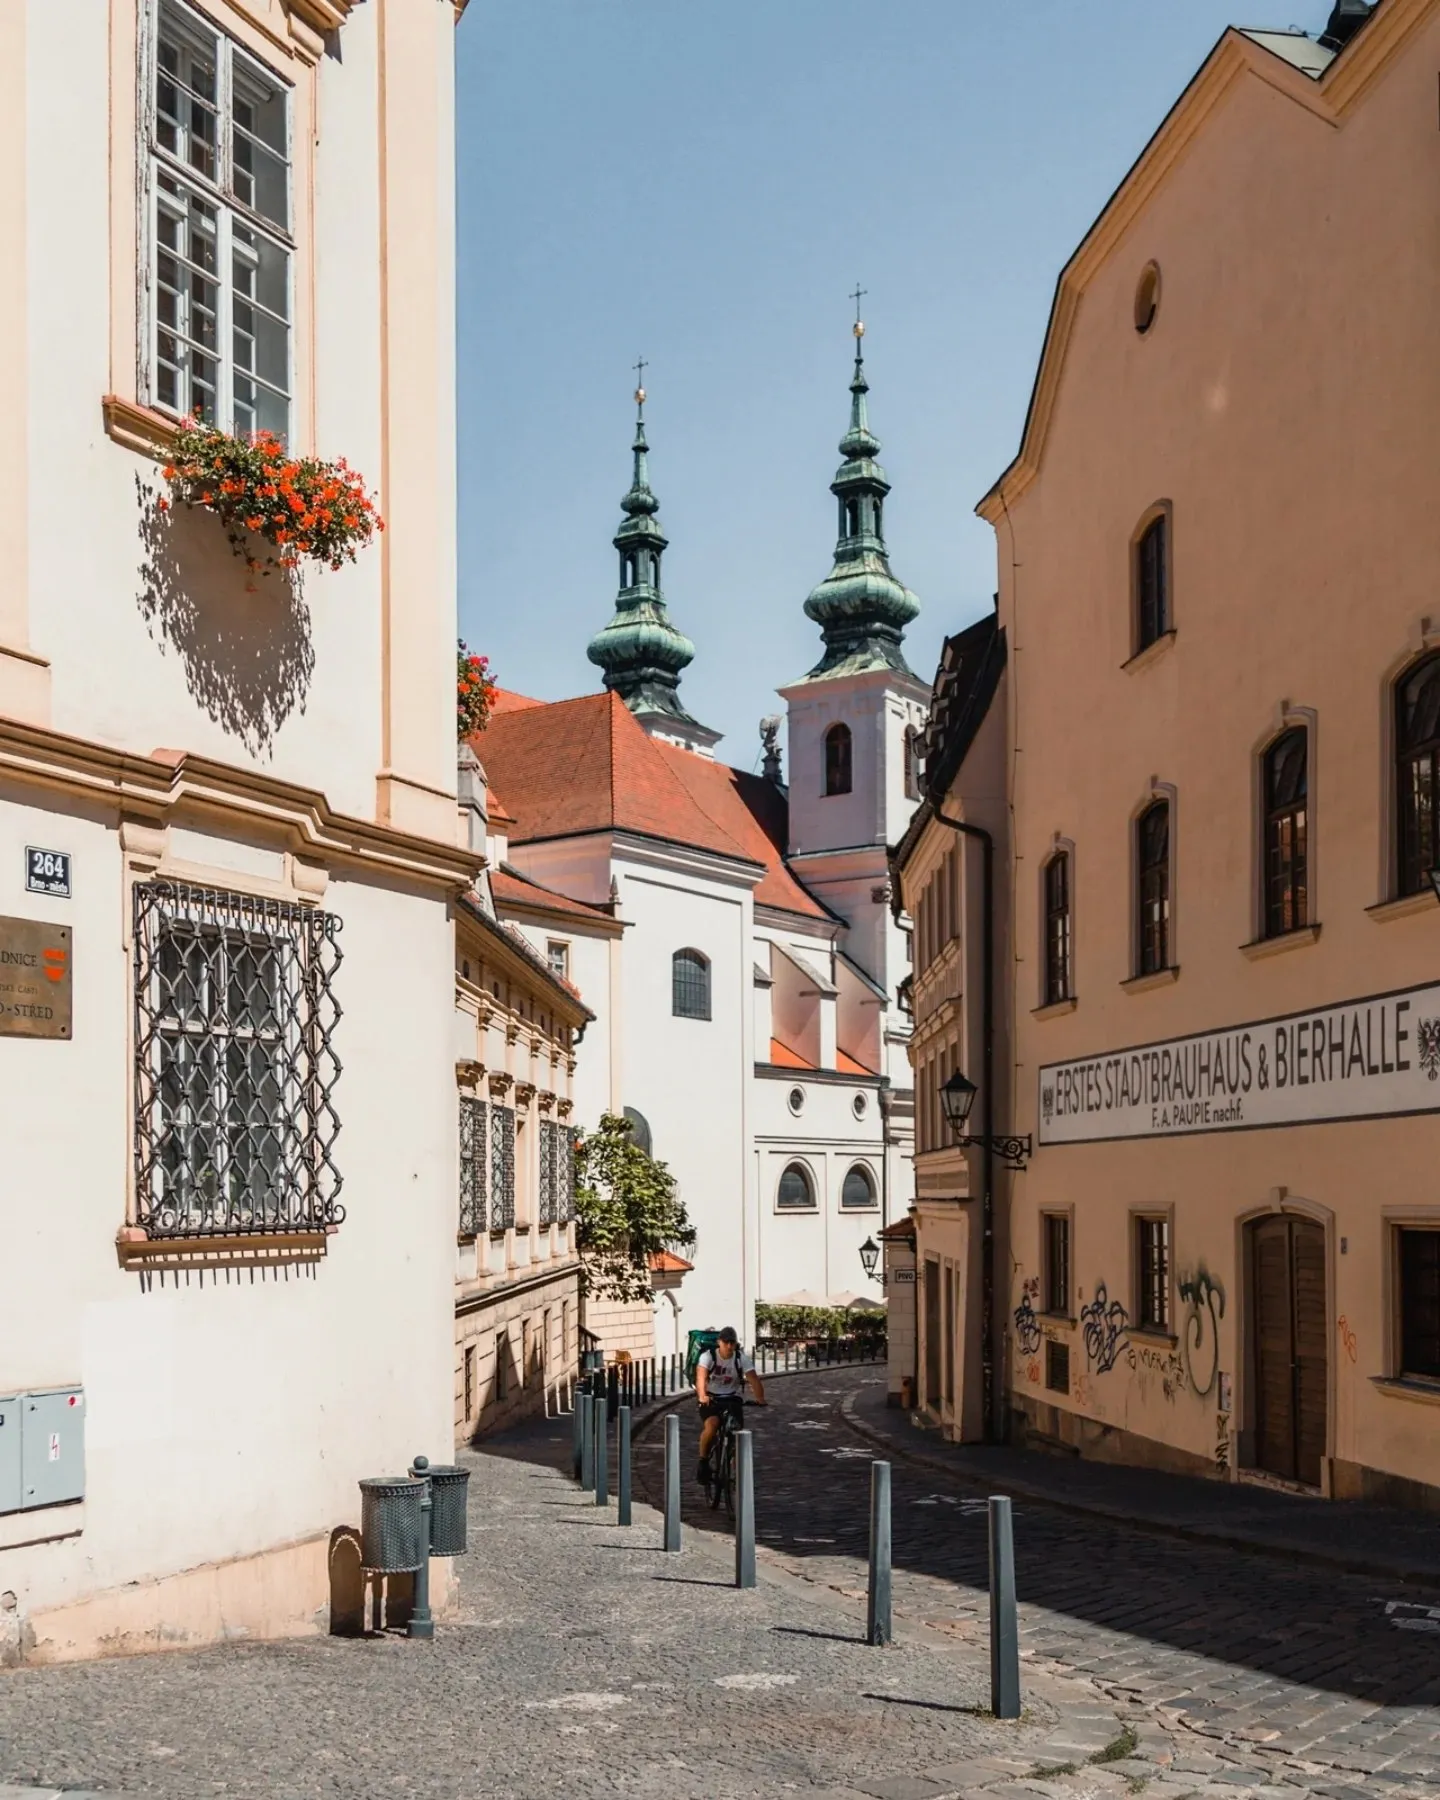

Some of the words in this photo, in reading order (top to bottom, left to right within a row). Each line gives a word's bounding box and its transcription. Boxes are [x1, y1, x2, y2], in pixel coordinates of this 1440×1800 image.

[33, 852, 64, 878] 264
[1, 950, 38, 967] DNICE
[1056, 1063, 1101, 1116] ERSTES
[1105, 1033, 1252, 1109] STADTBRAUHAUS
[1258, 1043, 1270, 1090] &
[1275, 1001, 1411, 1088] BIERHALLE
[1173, 1101, 1211, 1126] PAUPIE
[1213, 1097, 1244, 1123] nachf.
